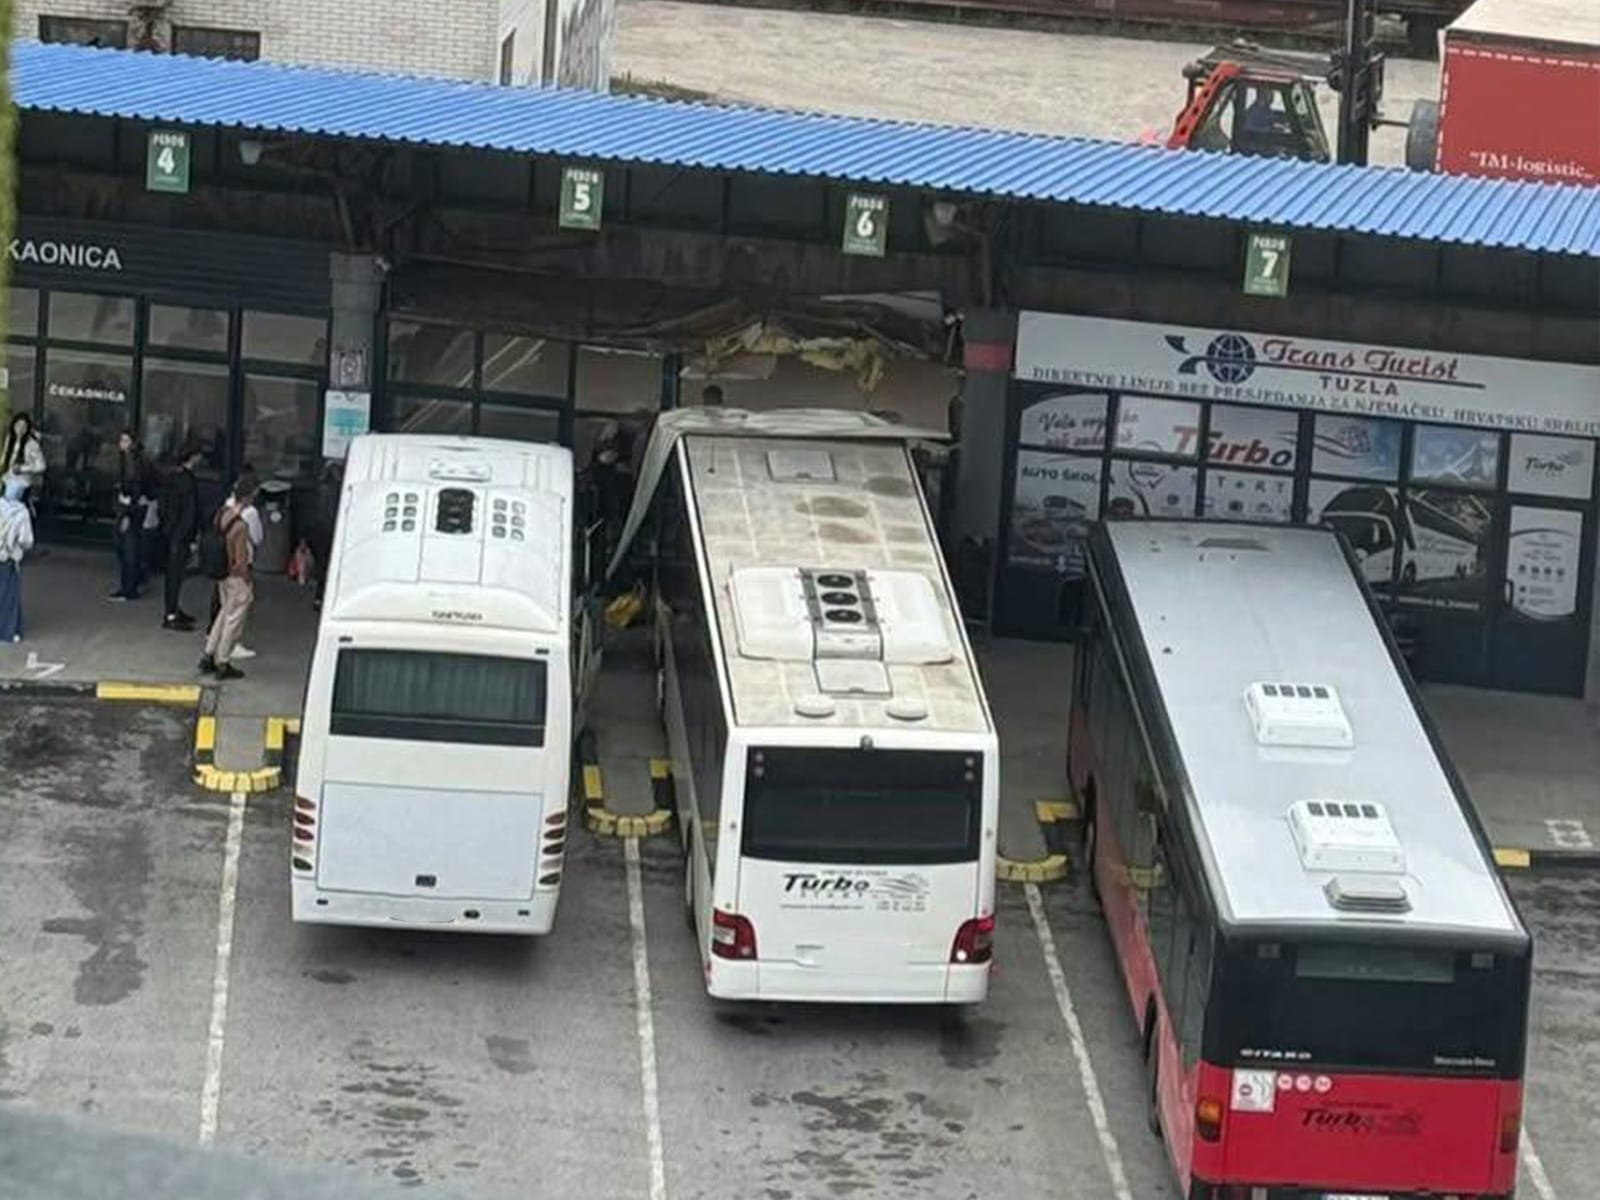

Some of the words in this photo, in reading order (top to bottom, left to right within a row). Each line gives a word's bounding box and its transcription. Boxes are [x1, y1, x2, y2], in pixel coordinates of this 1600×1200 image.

[157, 147, 175, 174] 4
[573, 183, 591, 211] 5
[856, 210, 874, 237] 6
[1261, 250, 1279, 277] 7
[1262, 338, 1355, 369] Trans
[1363, 349, 1460, 380] Turist
[1319, 375, 1399, 396] TUZLA
[1172, 424, 1294, 467] Turbo
[782, 872, 871, 893] Turbo
